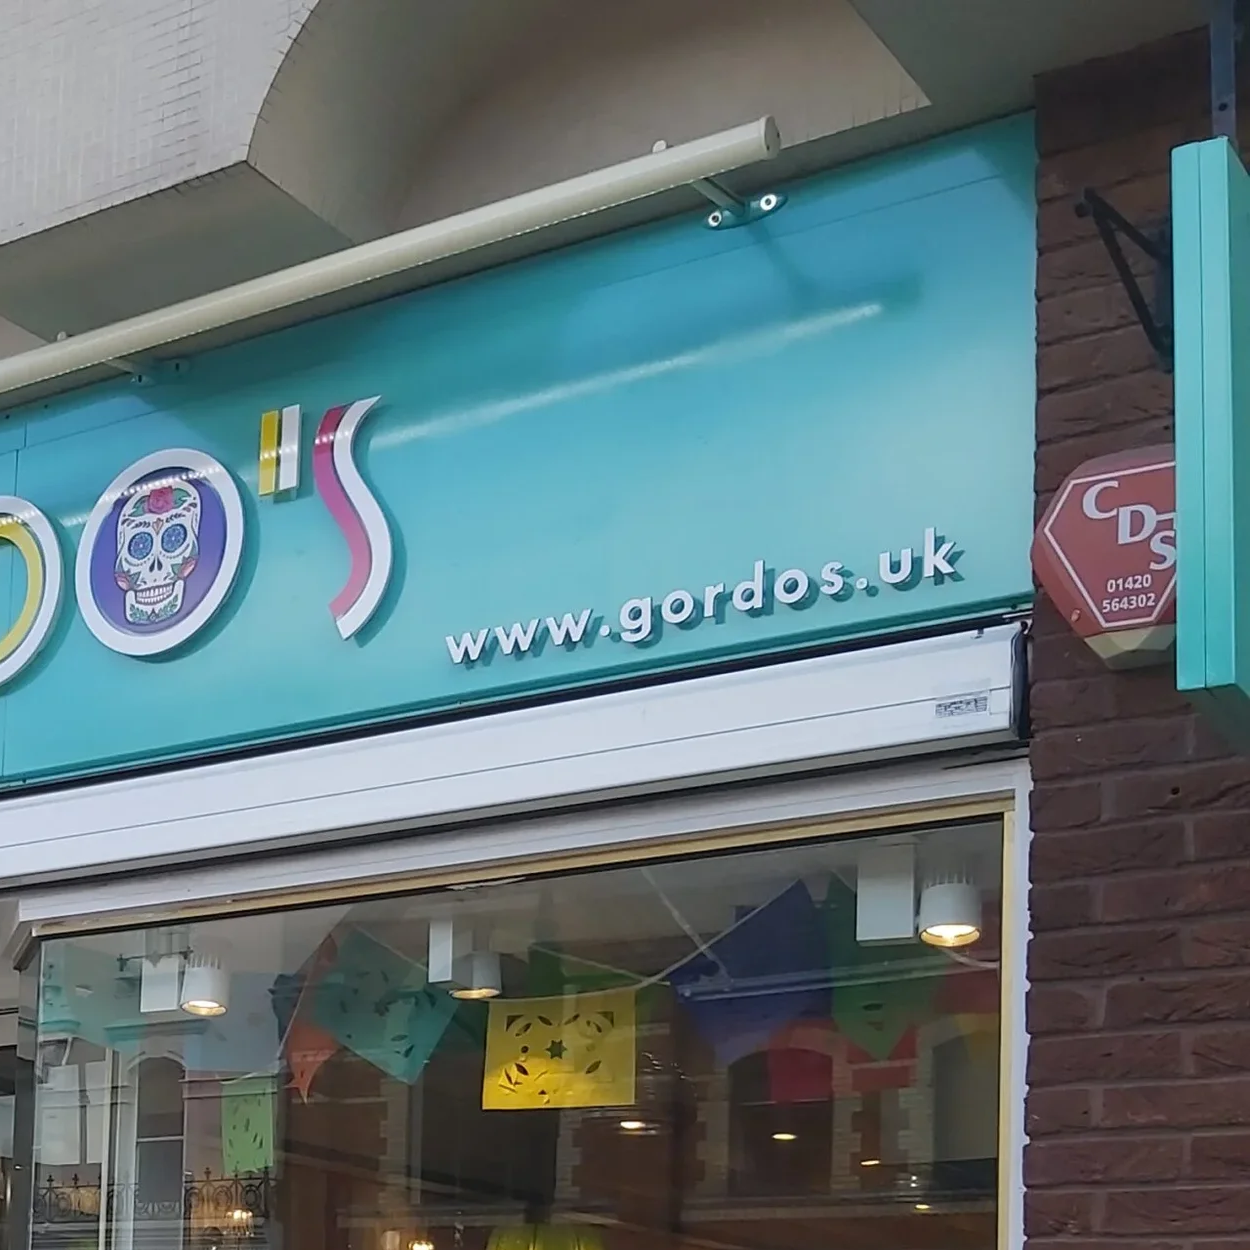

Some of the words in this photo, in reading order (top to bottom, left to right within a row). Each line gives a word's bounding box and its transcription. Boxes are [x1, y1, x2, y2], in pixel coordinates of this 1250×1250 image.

[1083, 480, 1177, 570] CDS
[445, 527, 956, 666] www.gordos.uk
[1102, 593, 1156, 613] 564302
[1106, 573, 1152, 593] 01420
